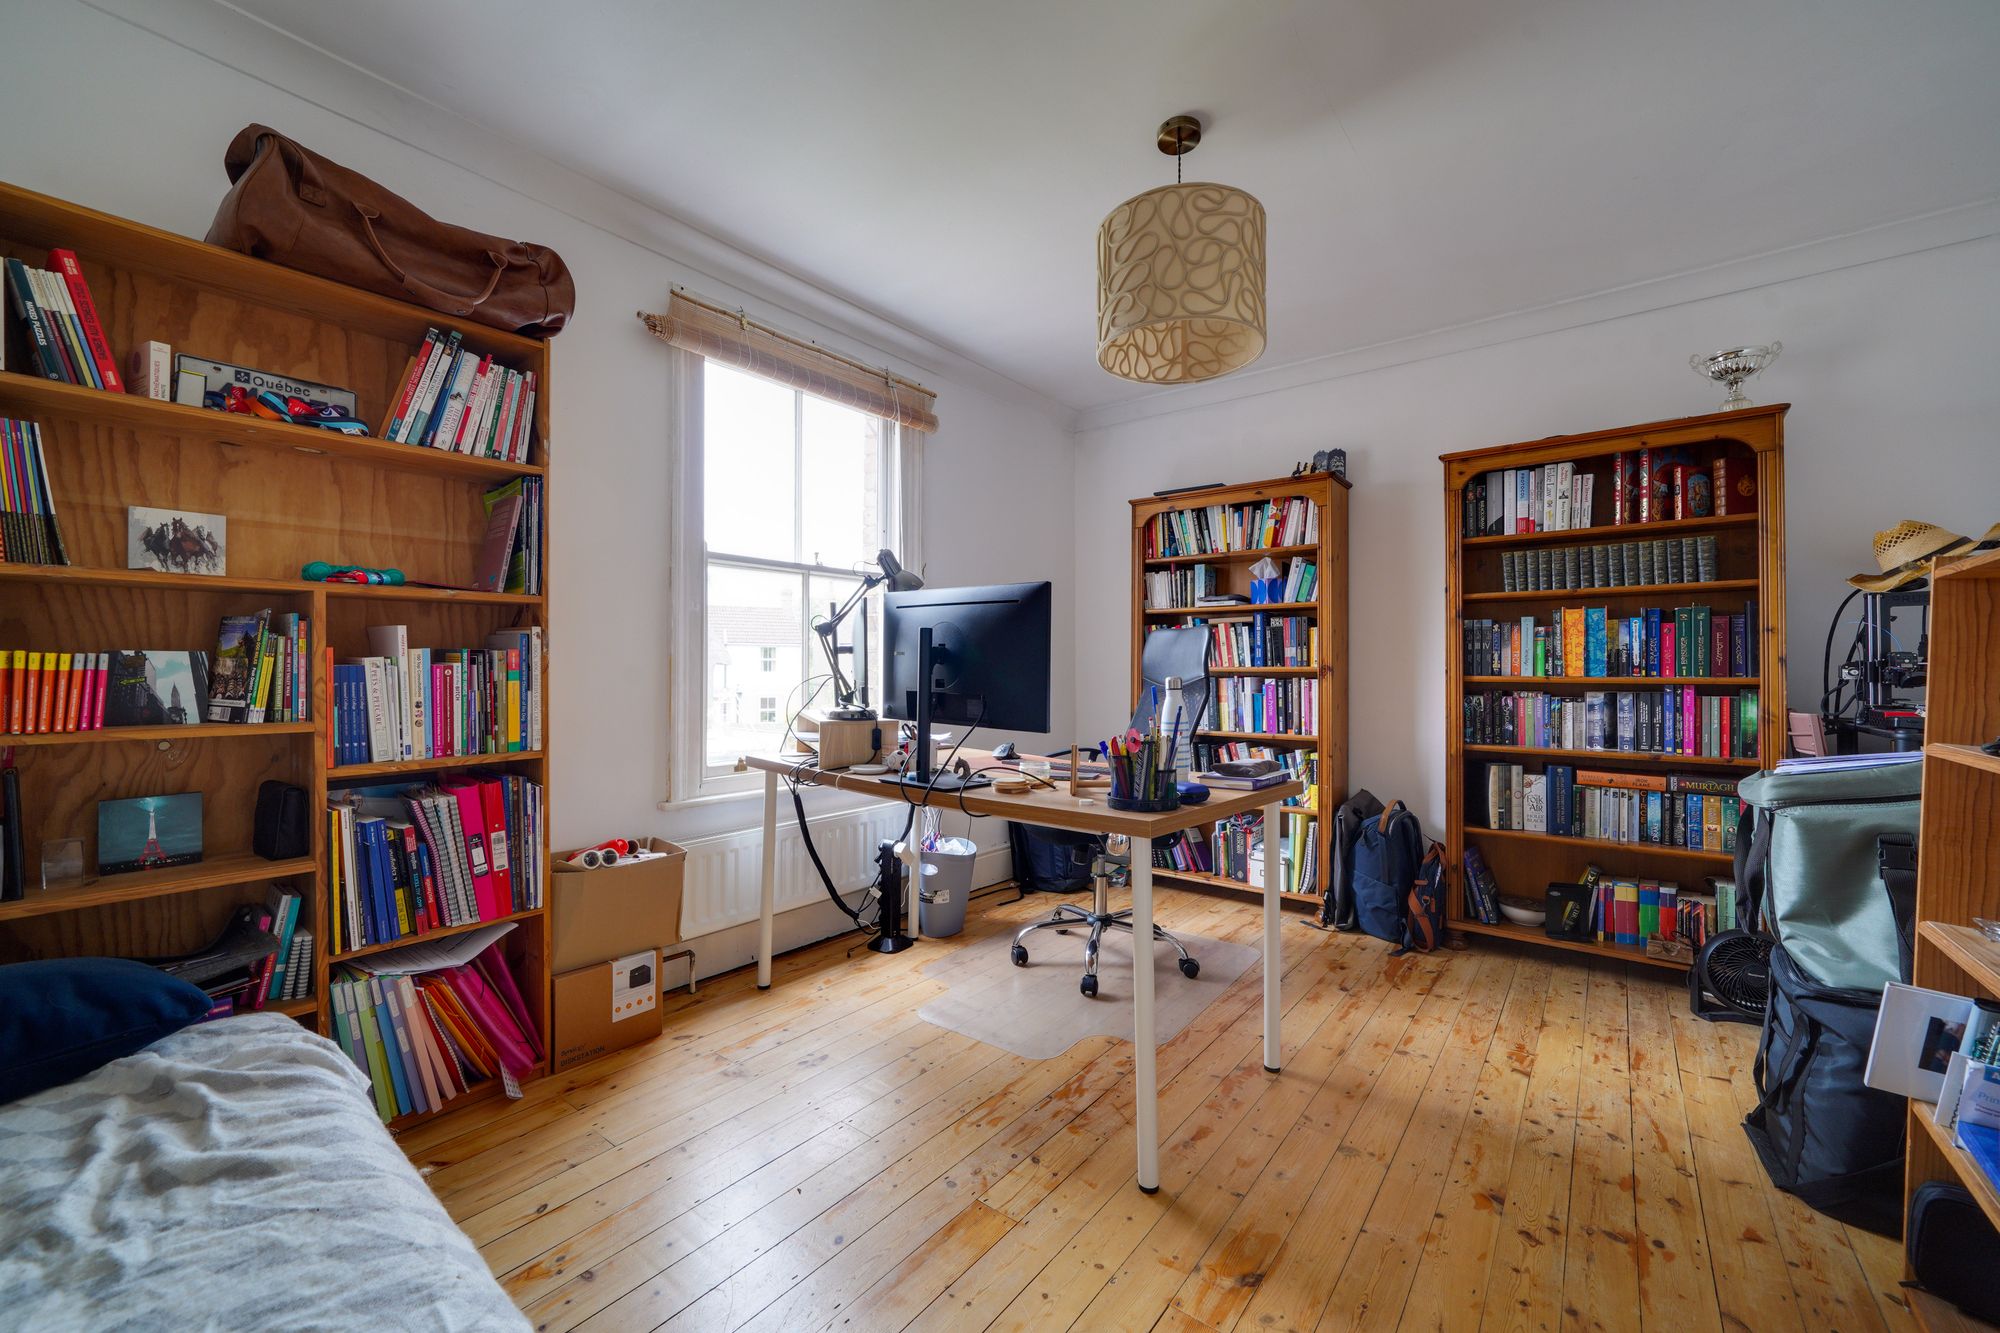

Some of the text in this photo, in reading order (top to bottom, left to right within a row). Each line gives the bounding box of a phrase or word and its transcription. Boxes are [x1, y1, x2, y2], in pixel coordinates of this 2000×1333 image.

[25, 300, 38, 320] MIXED
[32, 320, 47, 346] PUZZLES
[427, 350, 439, 369] HORSE
[253, 375, 311, 398] Québec
[415, 368, 432, 399] BEHAVIOUR
[427, 370, 440, 394] EXERCISES
[407, 399, 417, 417] Handbook
[440, 404, 454, 434] ANIMALS
[447, 408, 460, 434] HEROIC
[1546, 467, 1554, 482] Fake
[414, 669, 424, 697] Consultations
[372, 695, 382, 726] PETCARE
[1685, 781, 1734, 790] MURTAGH
[1526, 794, 1544, 805] FOLK
[1529, 804, 1544, 812] AIR
[410, 852, 418, 869] anglais
[560, 1045, 606, 1067] DISKSTATION
